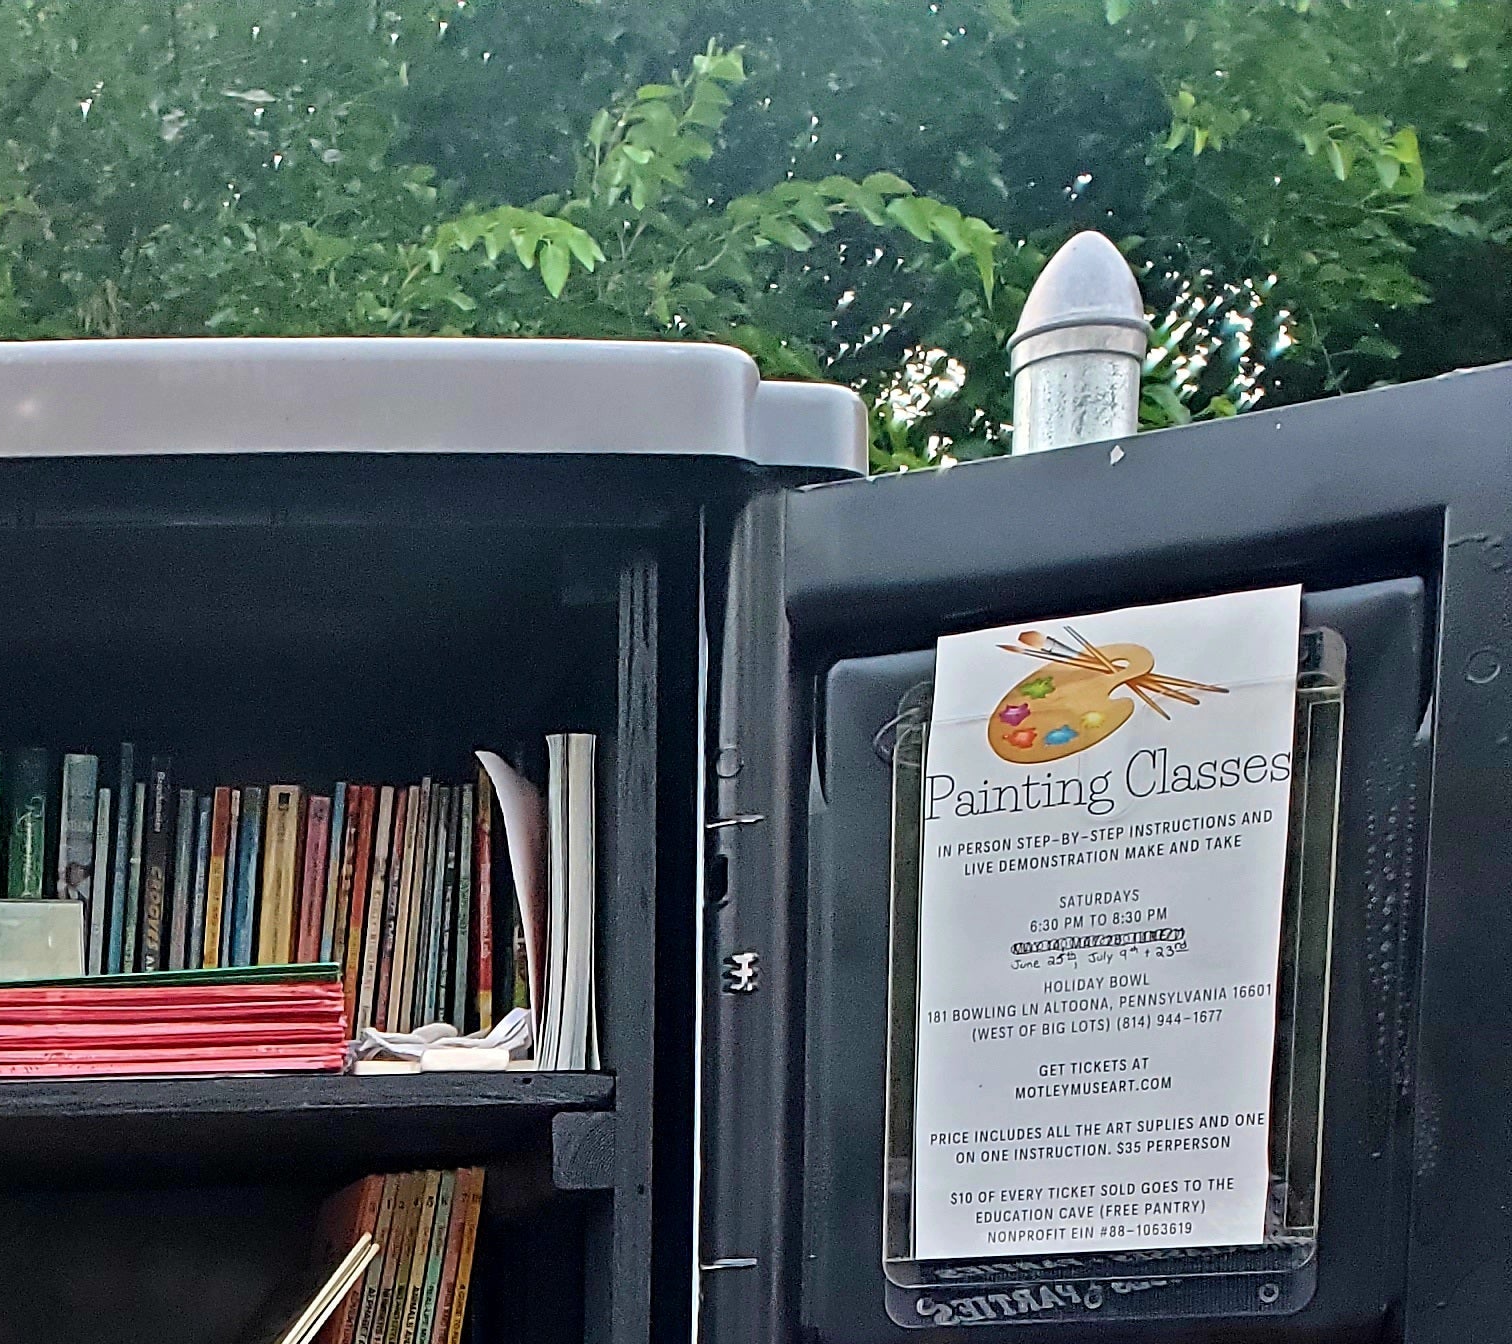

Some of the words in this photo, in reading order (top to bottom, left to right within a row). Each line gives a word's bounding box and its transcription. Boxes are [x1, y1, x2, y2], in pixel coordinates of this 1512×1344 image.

[925, 770, 1115, 820] Painting
[1126, 748, 1291, 798] Classes
[938, 845, 952, 858] IN
[958, 838, 1011, 856] PERSON
[1017, 826, 1123, 850] STEP-BY-STEP
[1130, 813, 1236, 838] INSTRUCTIONS
[1242, 810, 1273, 825] AND
[965, 861, 993, 876] LIVE
[999, 849, 1119, 872] DEMONSTRATION
[1125, 844, 1164, 860] MAKE
[1169, 840, 1200, 855] AND
[1206, 835, 1242, 850] TAKE
[1059, 889, 1140, 909] SATURDAYS
[1030, 918, 1059, 933] 6:30
[1064, 916, 1084, 930] PM
[1089, 913, 1107, 927] TO
[1112, 910, 1142, 925] 8:30
[1147, 907, 1167, 921] PM
[1044, 977, 1104, 994] HOLIDAY
[1110, 973, 1150, 988] BOWL
[927, 1010, 947, 1024] 181
[952, 1005, 1017, 1022] BOWLING
[1022, 1003, 1039, 1016] LN
[1044, 997, 1113, 1014] ALTOONA,
[1119, 987, 1227, 1009] PENNSYLVANIA
[1233, 983, 1272, 999] 16601
[972, 1025, 1014, 1042] (WEST
[1018, 1023, 1037, 1037] OF
[1042, 1022, 1065, 1035] BIG
[1071, 1017, 1110, 1033] LOTS)
[1117, 1015, 1151, 1031] (814)
[1157, 1009, 1223, 1027] 944-1677
[1039, 1063, 1065, 1077] GET
[1070, 1059, 1127, 1075] TICKETS
[1131, 1057, 1149, 1070] AT
[1015, 1077, 1172, 1099] MOTLEYMUSEART.COM
[930, 1131, 969, 1146] PRICE
[974, 1127, 1042, 1143] INCLUDES
[1047, 1125, 1071, 1138] ALL
[1076, 1123, 1101, 1137] THE
[1106, 1121, 1132, 1135] ART
[1137, 1117, 1194, 1133] SUPLIES
[1199, 1115, 1229, 1129] AND
[1235, 1112, 1265, 1127] ONE
[956, 1151, 975, 1164] ON
[981, 1149, 1009, 1162] ONE
[1014, 1143, 1111, 1161] INSTRUCTION.
[1117, 1140, 1141, 1155] $35
[1147, 1135, 1231, 1152] PERPERSON
[950, 1192, 972, 1205] $10
[978, 1190, 996, 1203] OF
[1000, 1188, 1043, 1202] EVERY
[1048, 1185, 1096, 1199] TICKET
[1100, 1183, 1135, 1197] SOLD
[1141, 1180, 1178, 1194] GOES
[1184, 1179, 1202, 1192] TO
[1208, 1177, 1235, 1191] THE
[976, 1208, 1053, 1224] EDUCATION
[1059, 1206, 1094, 1220] CAVE
[1099, 1204, 1139, 1219] (FREE
[1144, 1199, 1206, 1215] PANTRY)
[988, 1228, 1066, 1243] NONPROFIT
[1071, 1227, 1094, 1239] EIN
[1100, 1222, 1192, 1238] #88-1063619
